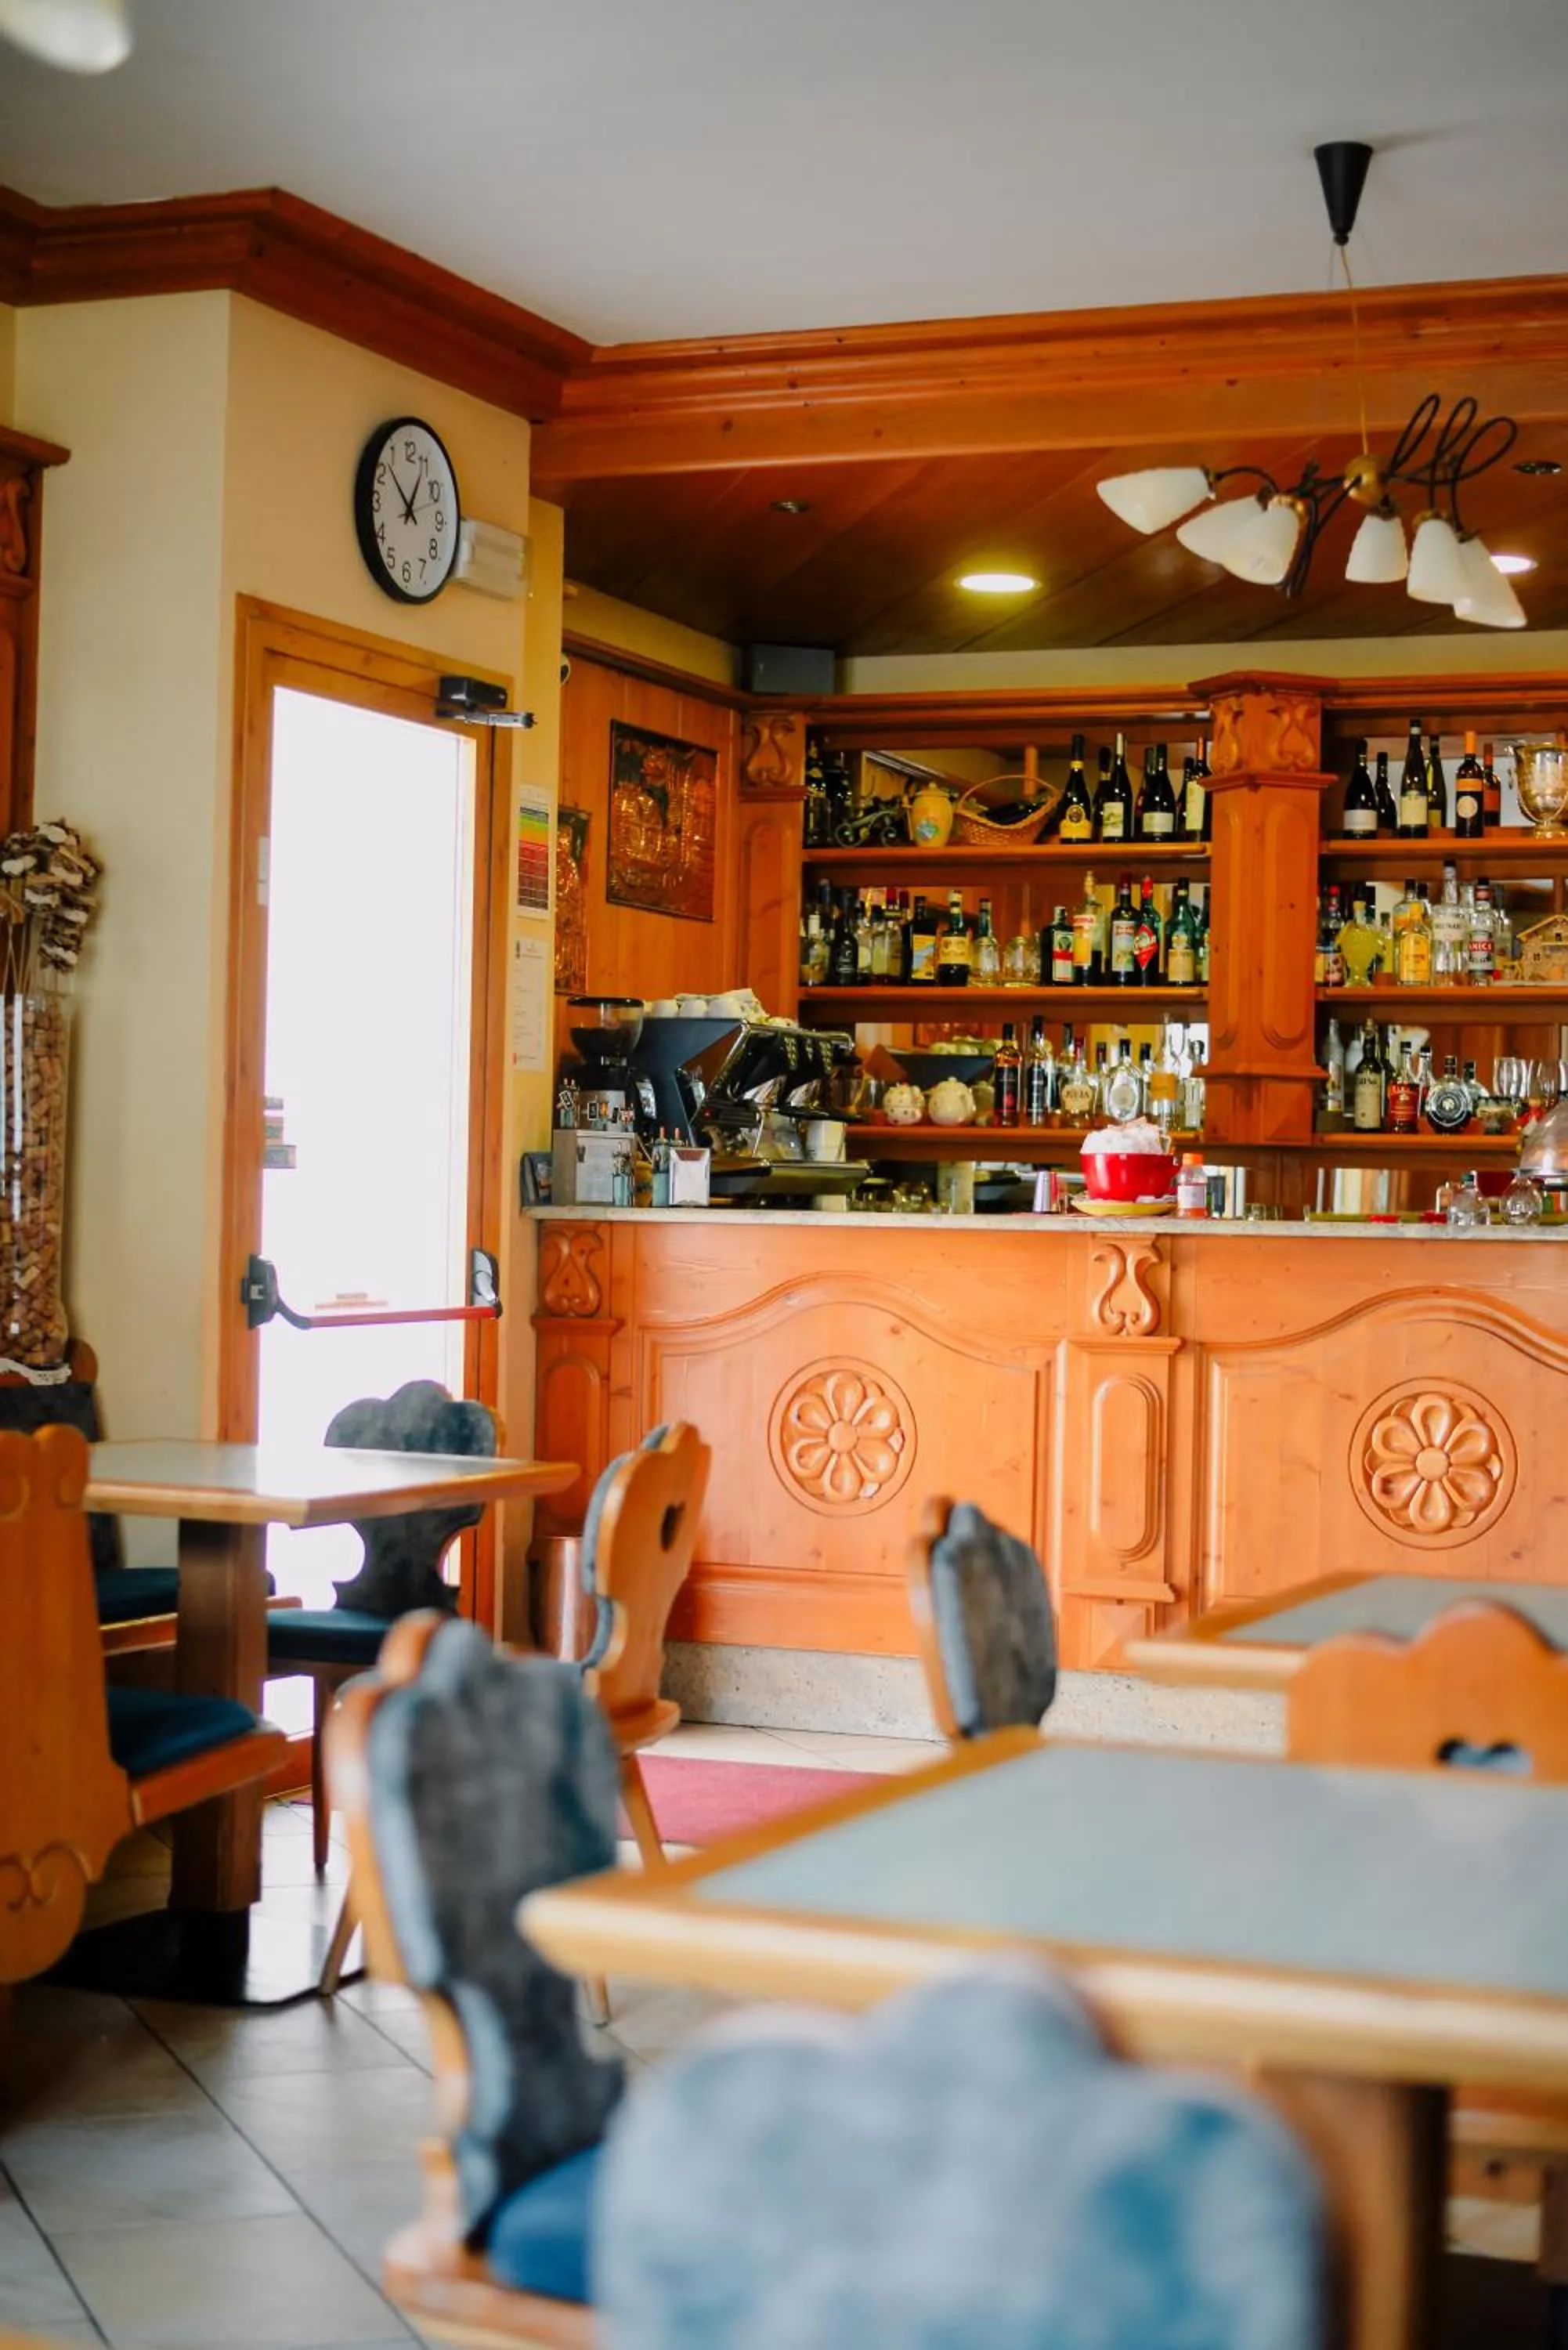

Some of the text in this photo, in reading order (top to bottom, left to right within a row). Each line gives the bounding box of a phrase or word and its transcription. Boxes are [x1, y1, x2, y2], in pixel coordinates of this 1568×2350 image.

[389, 445, 395, 469] 1
[404, 441, 417, 464] 12
[377, 462, 386, 486] 2
[418, 454, 428, 478] 11
[372, 490, 381, 512] 3
[428, 479, 441, 503] 10
[376, 521, 386, 545] 4
[435, 511, 444, 532] 9
[387, 547, 396, 570] 5
[428, 538, 438, 560] 8
[402, 561, 411, 583] 6
[417, 559, 427, 580] 7
